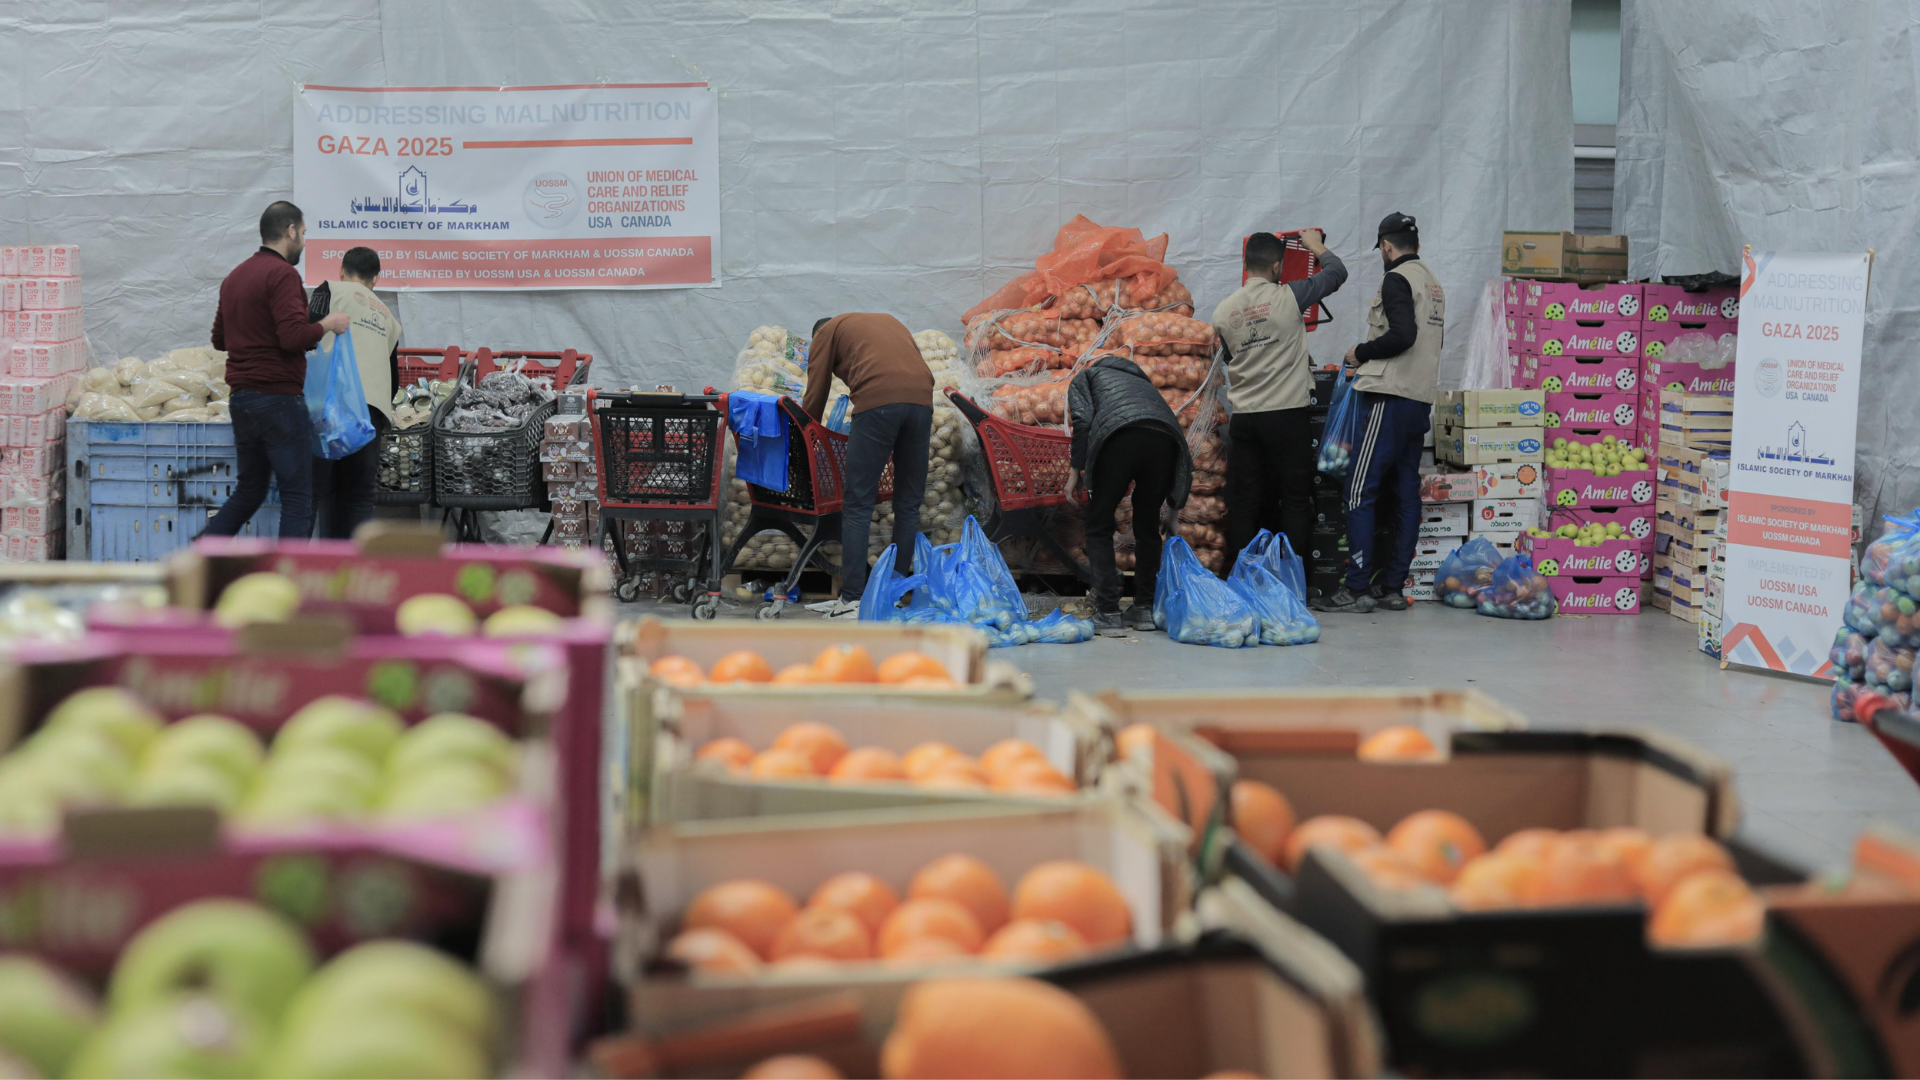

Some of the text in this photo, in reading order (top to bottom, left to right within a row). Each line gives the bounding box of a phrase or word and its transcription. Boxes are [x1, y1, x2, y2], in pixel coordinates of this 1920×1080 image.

[317, 101, 691, 125] ADDRESSING MALNUTRITION
[318, 135, 453, 156] GAZA 2025
[535, 179, 568, 187] UOSSM
[587, 170, 698, 183] UNION OF MEDICAL
[588, 185, 689, 198] CARE AND RELIEF
[588, 200, 685, 213] ORGANIZATIONS
[318, 220, 510, 230] ISLAMIC SOCIETY OF MARKHAM
[588, 215, 672, 228] USA CANADA
[322, 248, 694, 260] SPOED BY ISLAMIC SOCIETY OF MARKHAM & UOSSM CANADA
[376, 268, 645, 278] MPLEMENTED BY UOSSM USA & UOSSM CANADA
[1767, 273, 1862, 291] ADDRESSING
[1568, 298, 1615, 314] Amélie
[1672, 300, 1718, 316] Amélie
[1754, 295, 1862, 314] MALNUTRITION
[1762, 322, 1839, 341] GAZA 2025
[1566, 335, 1614, 350] Amélie
[1788, 360, 1844, 371] UNION OF MEDICAL
[1566, 372, 1612, 386] Amélie
[1787, 370, 1840, 381] CARE AND RELIEF
[1688, 376, 1735, 392] Amélie
[1786, 380, 1836, 392] ORGANIZATIONS
[1786, 392, 1828, 402] USA CANADA
[1564, 408, 1610, 422] Amélie
[1738, 463, 1767, 473] ISLAMIC
[1769, 466, 1801, 476] SOCIETY
[1804, 470, 1813, 478] OF
[1581, 484, 1628, 500] Amélie
[1770, 504, 1806, 514] SPONSORED
[1738, 514, 1848, 536] ISLAMIC SOCIETY OF MARKHAM
[1762, 531, 1820, 546] UOSSM CANADA
[1562, 554, 1612, 570] Amélie
[1748, 560, 1833, 580] IMPLEMENTED BY
[1760, 579, 1818, 597] UOSSM USA
[1562, 592, 1612, 608] Amélie
[1748, 595, 1828, 617] UOSSM CANADA
